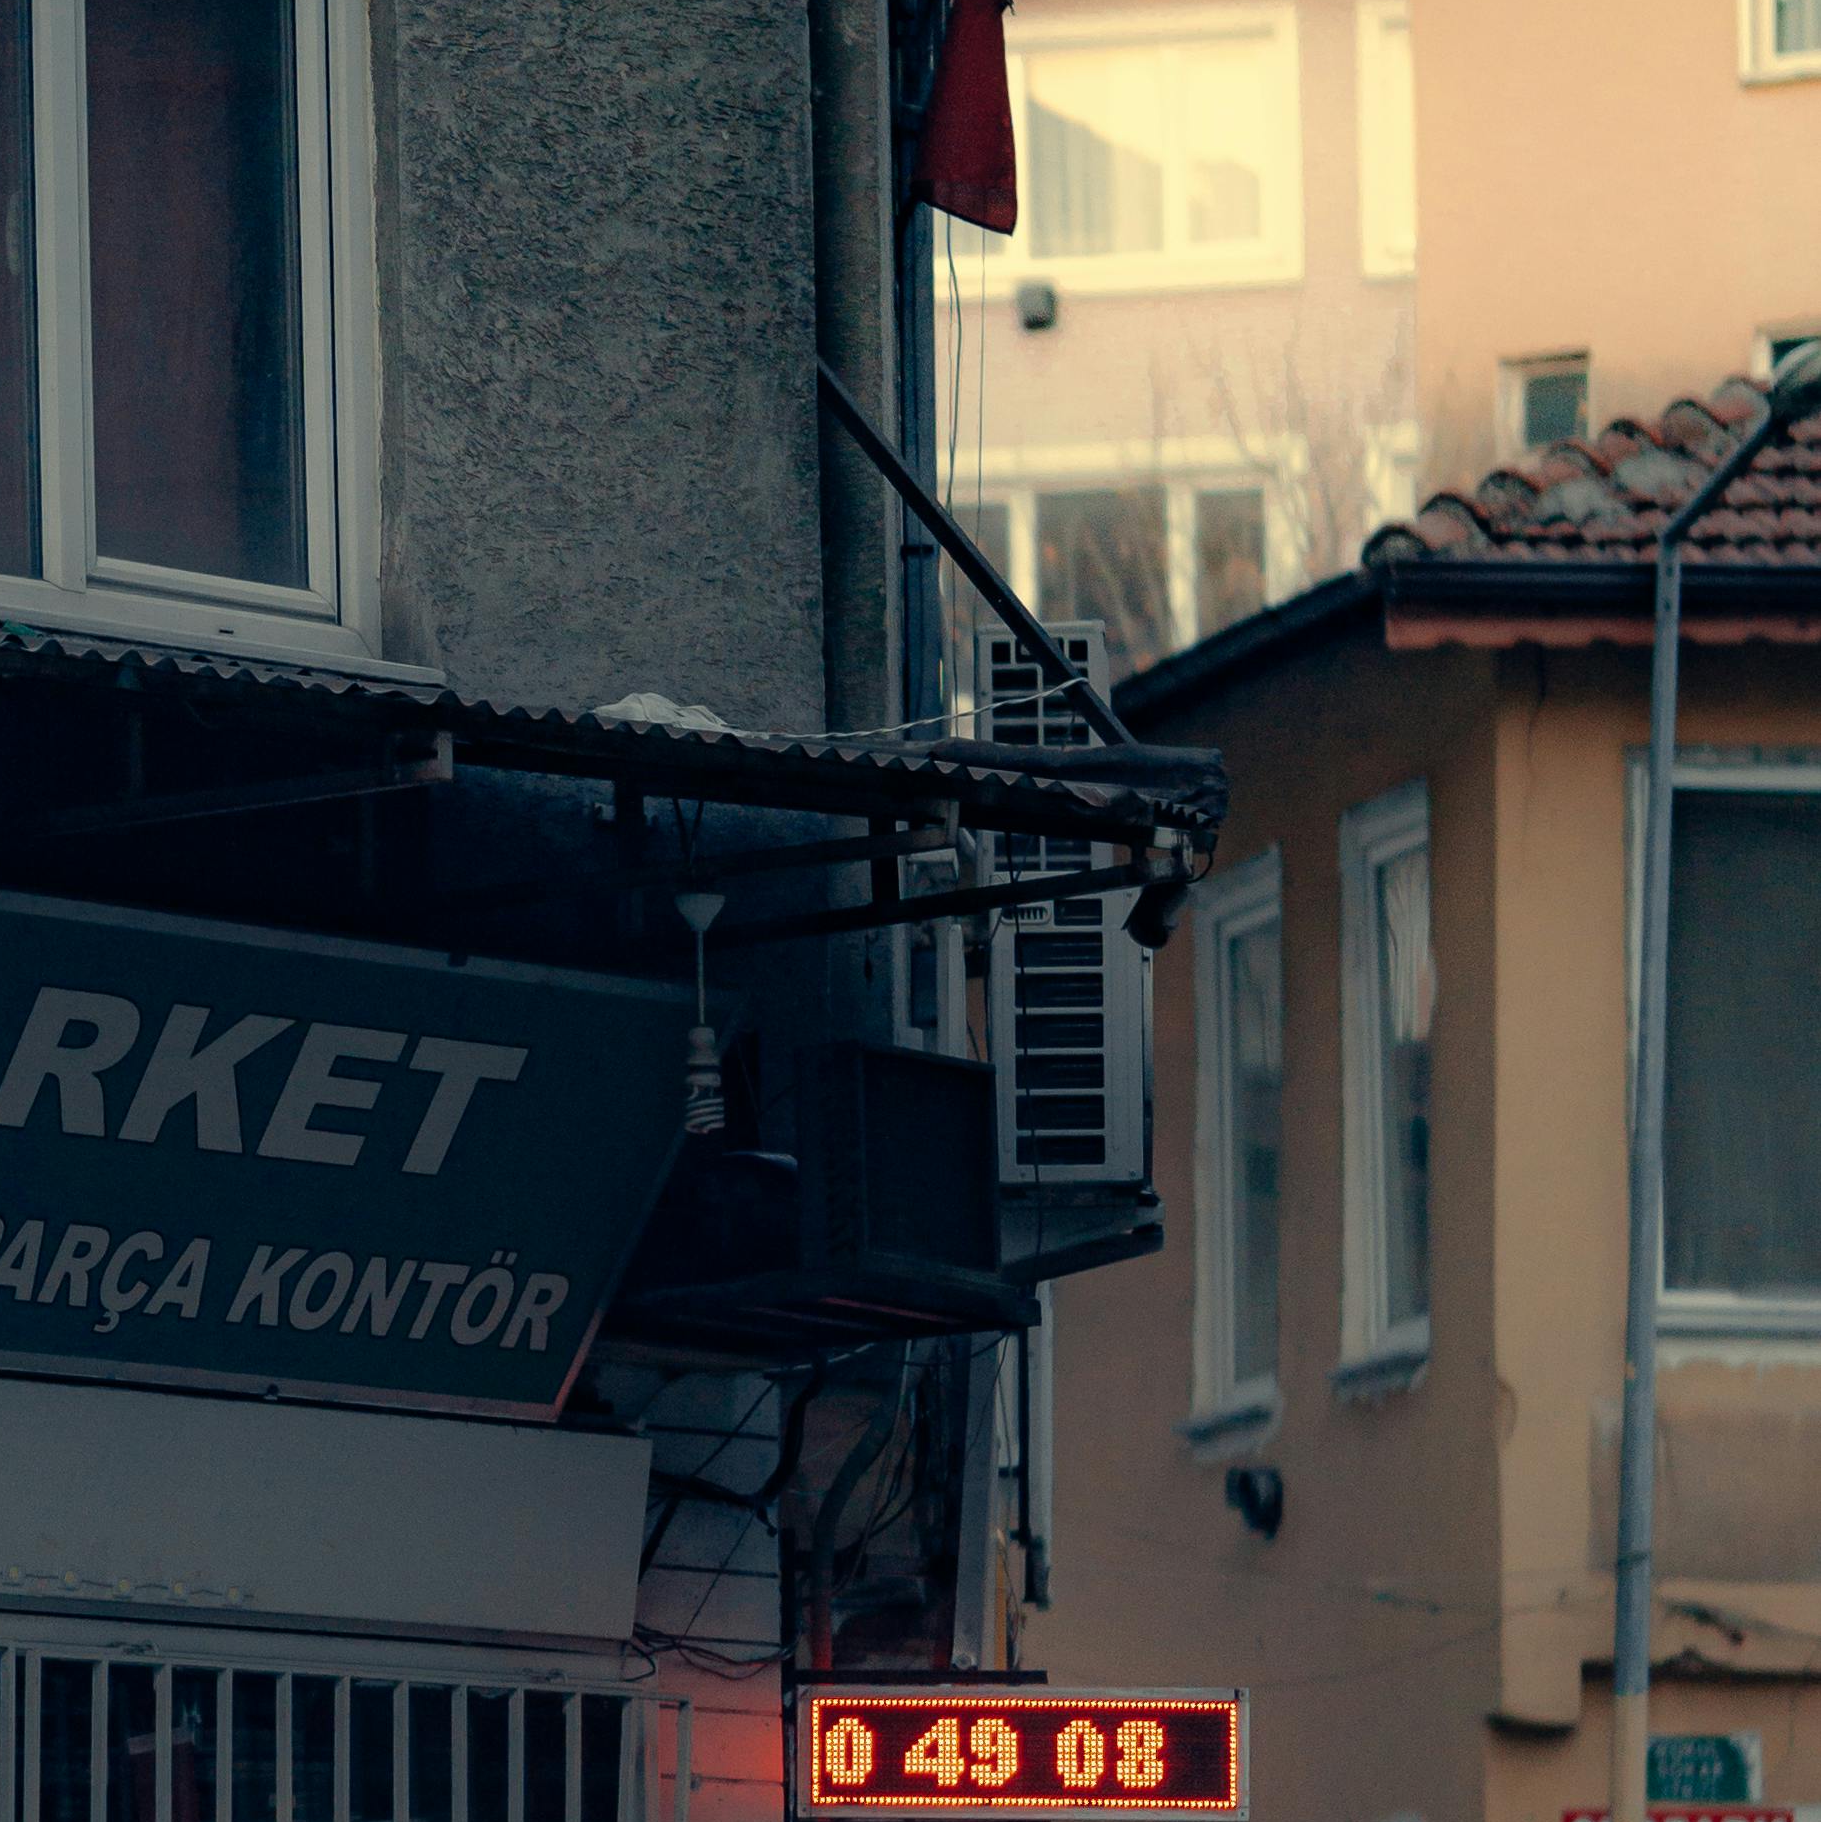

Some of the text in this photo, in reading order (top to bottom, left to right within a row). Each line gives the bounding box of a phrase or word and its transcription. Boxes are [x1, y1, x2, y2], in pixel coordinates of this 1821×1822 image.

[225, 1244, 570, 1353] KONTÖR
[903, 1717, 1019, 1787] 49
[1056, 1719, 1165, 1789] 08
